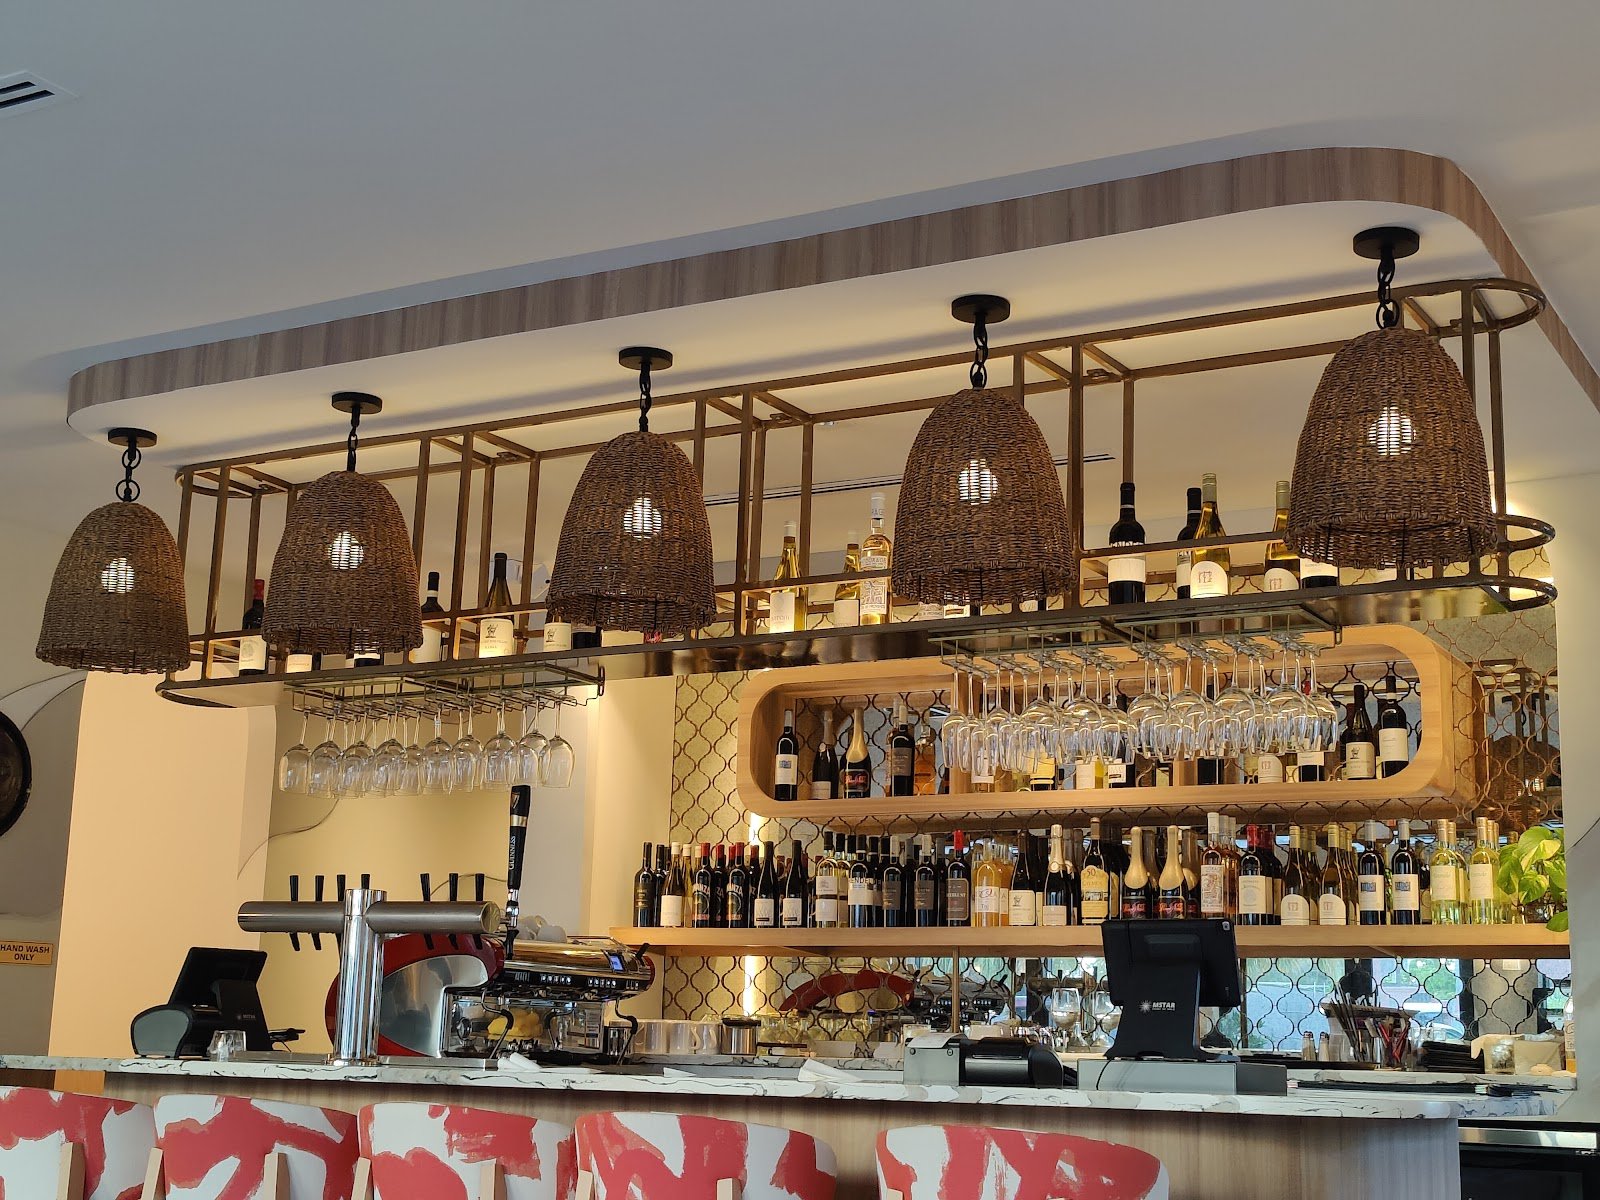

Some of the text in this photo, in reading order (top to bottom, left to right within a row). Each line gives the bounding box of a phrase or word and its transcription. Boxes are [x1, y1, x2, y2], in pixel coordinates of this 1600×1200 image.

[0, 944, 50, 953] HAND WASH
[14, 953, 35, 961] ONLY
